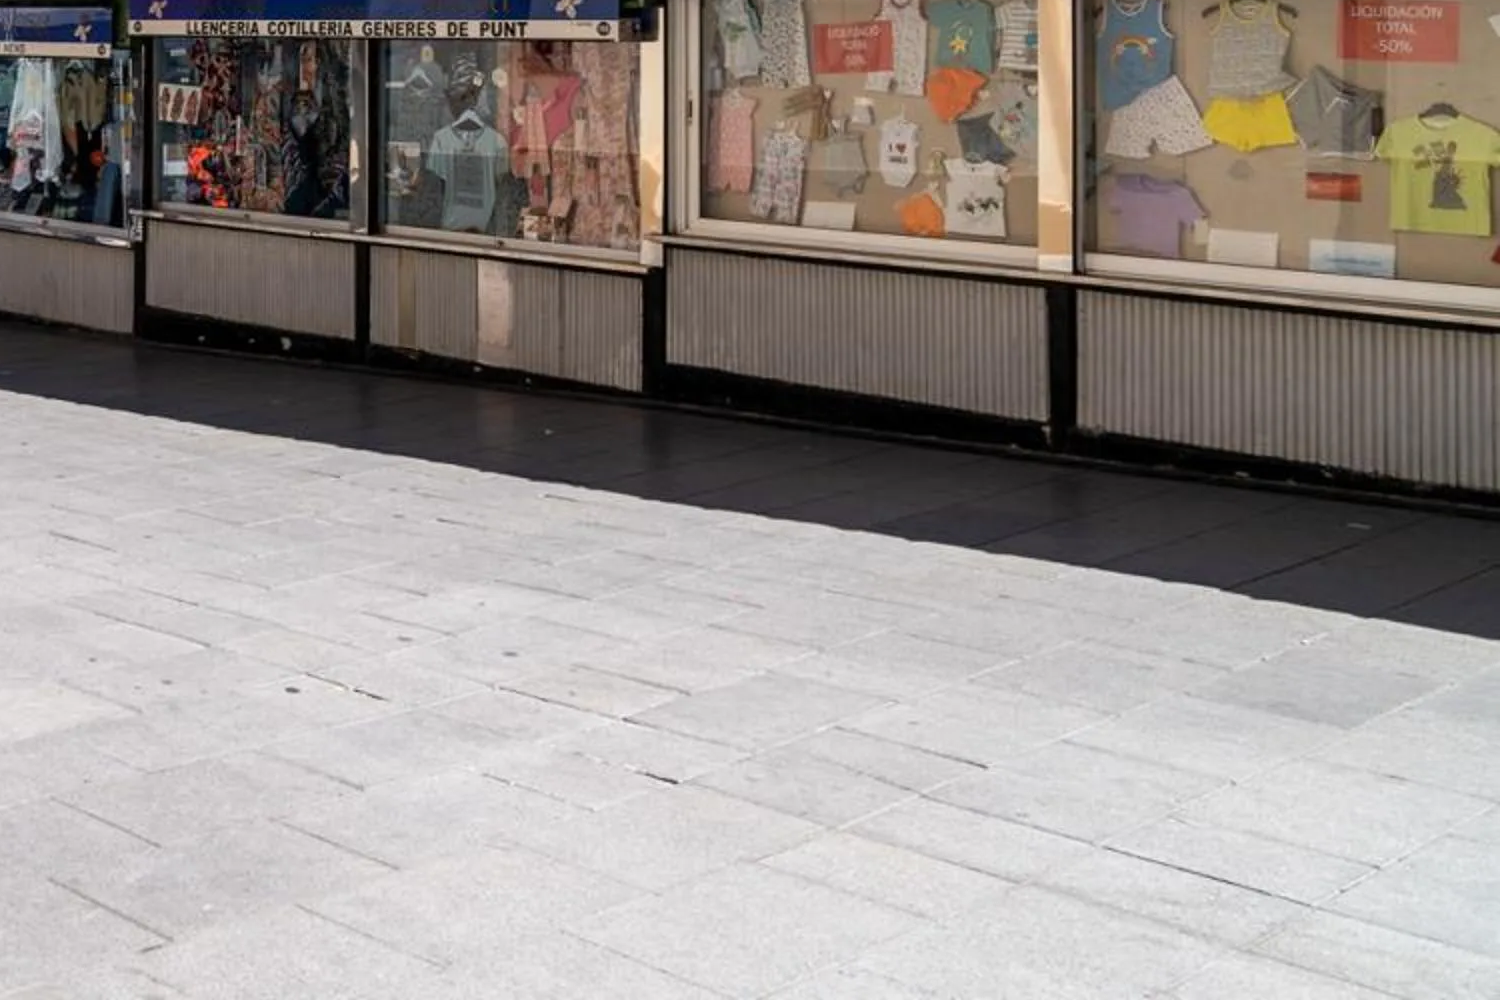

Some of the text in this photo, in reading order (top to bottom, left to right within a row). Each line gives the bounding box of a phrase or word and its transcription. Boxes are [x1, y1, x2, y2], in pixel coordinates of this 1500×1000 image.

[186, 20, 529, 38] LLENCERIA COTILLERIA GENERES DE PUNT
[1376, 21, 1416, 35] TOTAL
